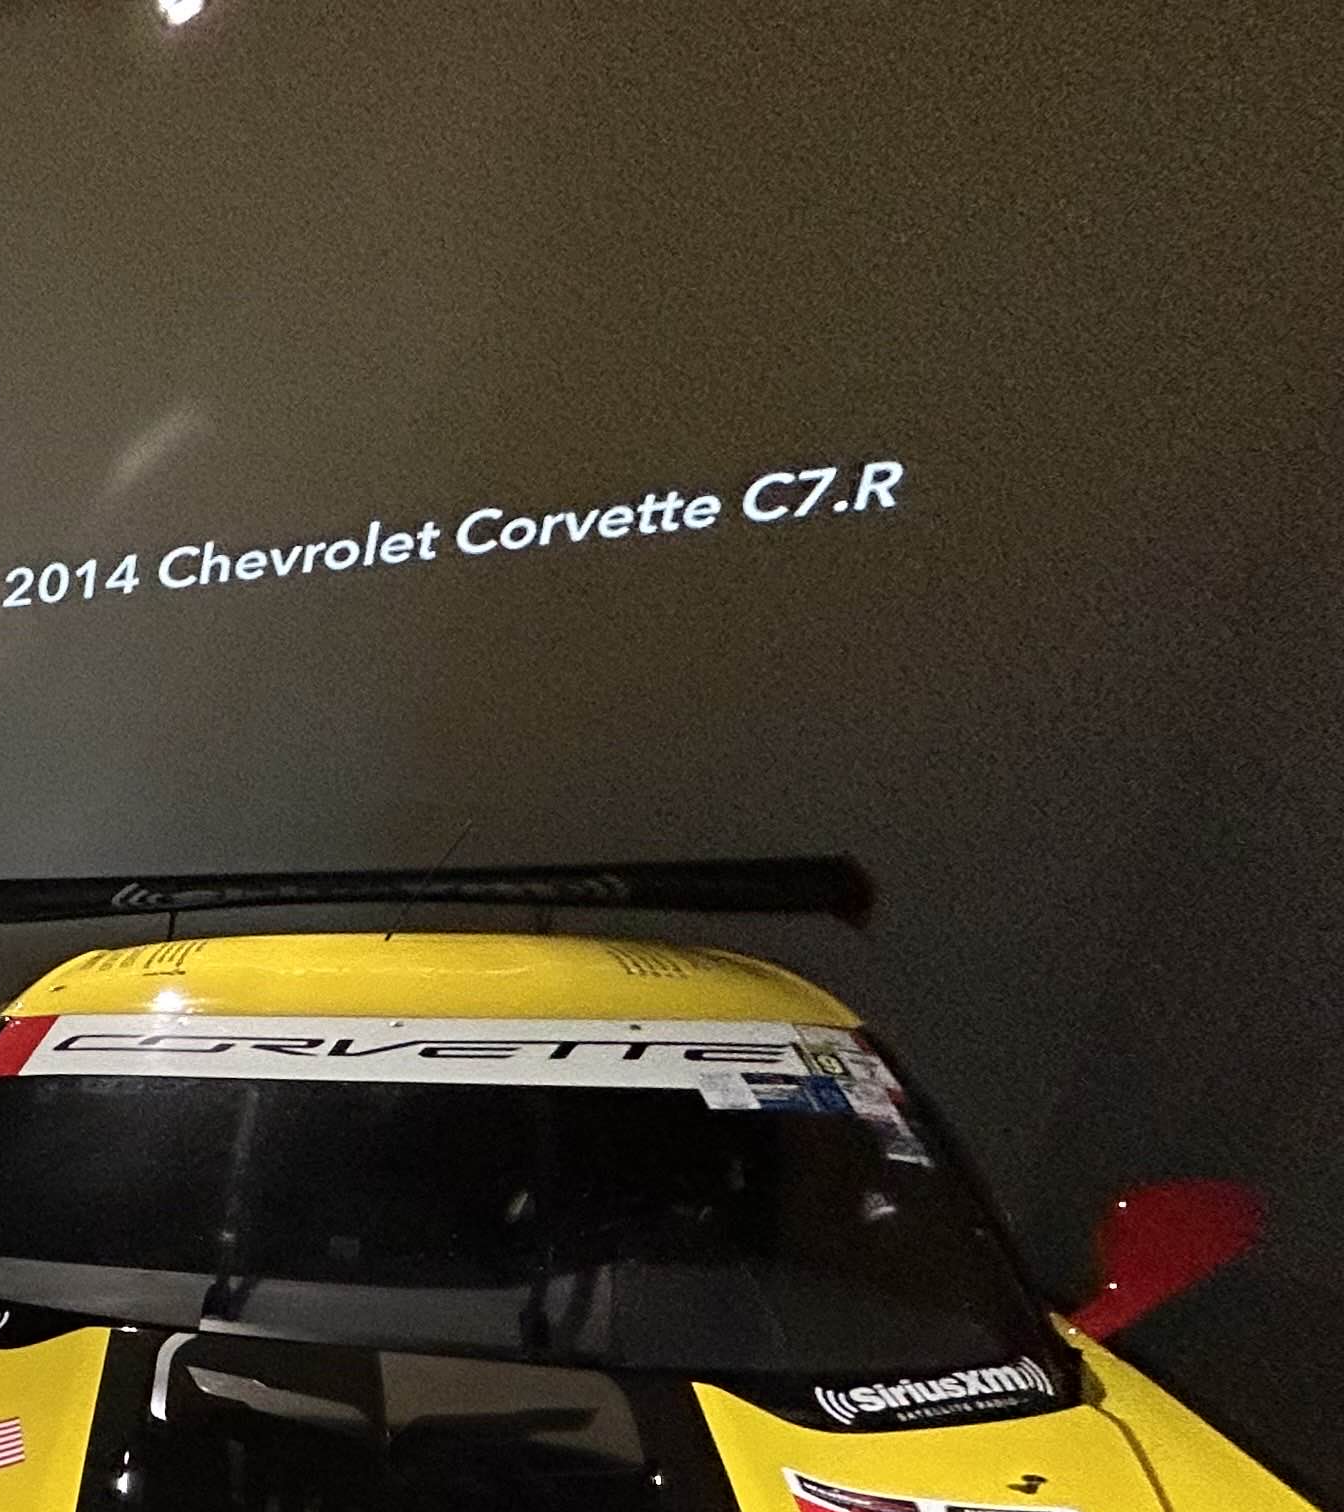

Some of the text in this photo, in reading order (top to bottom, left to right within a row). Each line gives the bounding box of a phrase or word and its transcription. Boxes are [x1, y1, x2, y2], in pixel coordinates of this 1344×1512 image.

[1, 460, 906, 608] 2014 Chevrolet Corvette C7.R
[52, 1032, 794, 1065] CORVETTE
